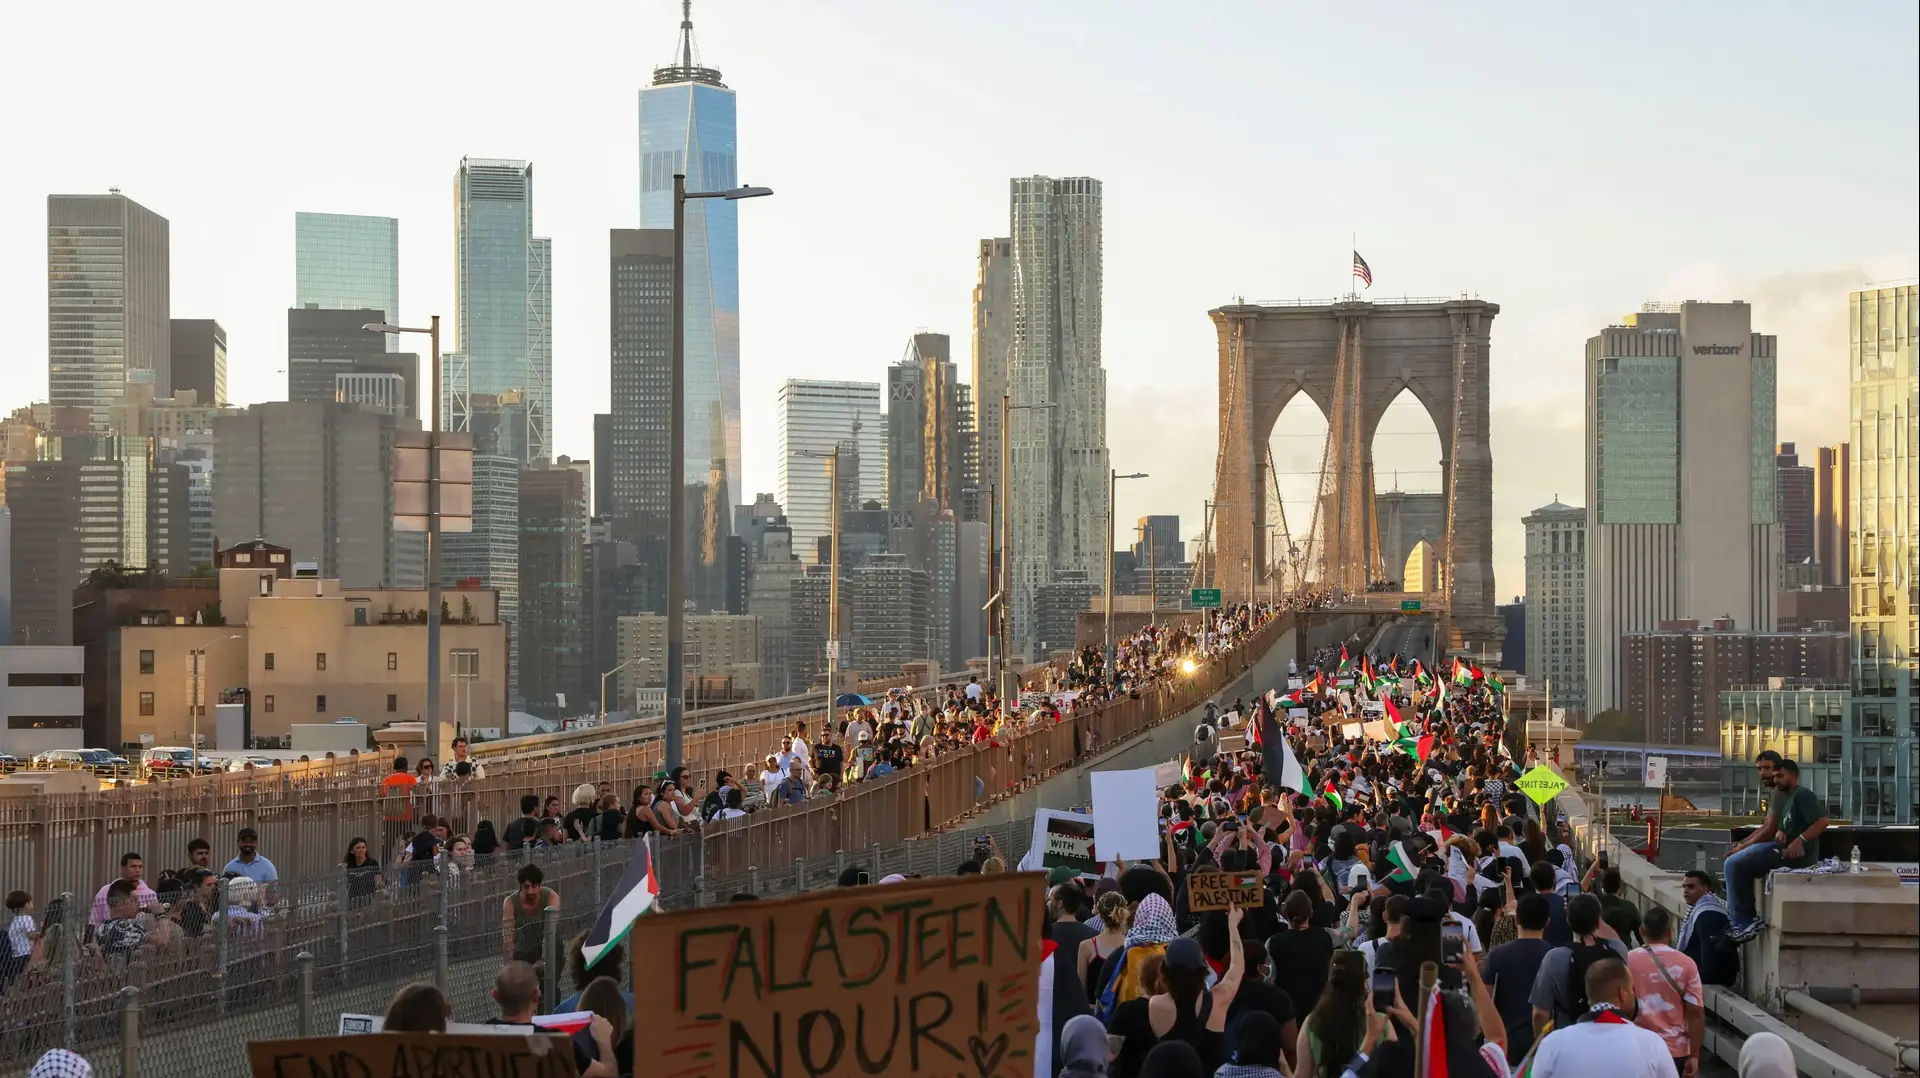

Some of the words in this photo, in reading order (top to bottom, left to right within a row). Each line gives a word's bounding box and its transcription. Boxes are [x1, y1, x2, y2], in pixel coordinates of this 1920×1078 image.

[1692, 343, 1740, 355] verizon
[1050, 839, 1075, 850] WITH
[1896, 866, 1918, 874] Coach
[1190, 874, 1229, 889] FREE
[1193, 888, 1260, 907] PALESTINE
[675, 887, 1031, 1015] FALASTEEN
[729, 980, 989, 1078] NOUR!
